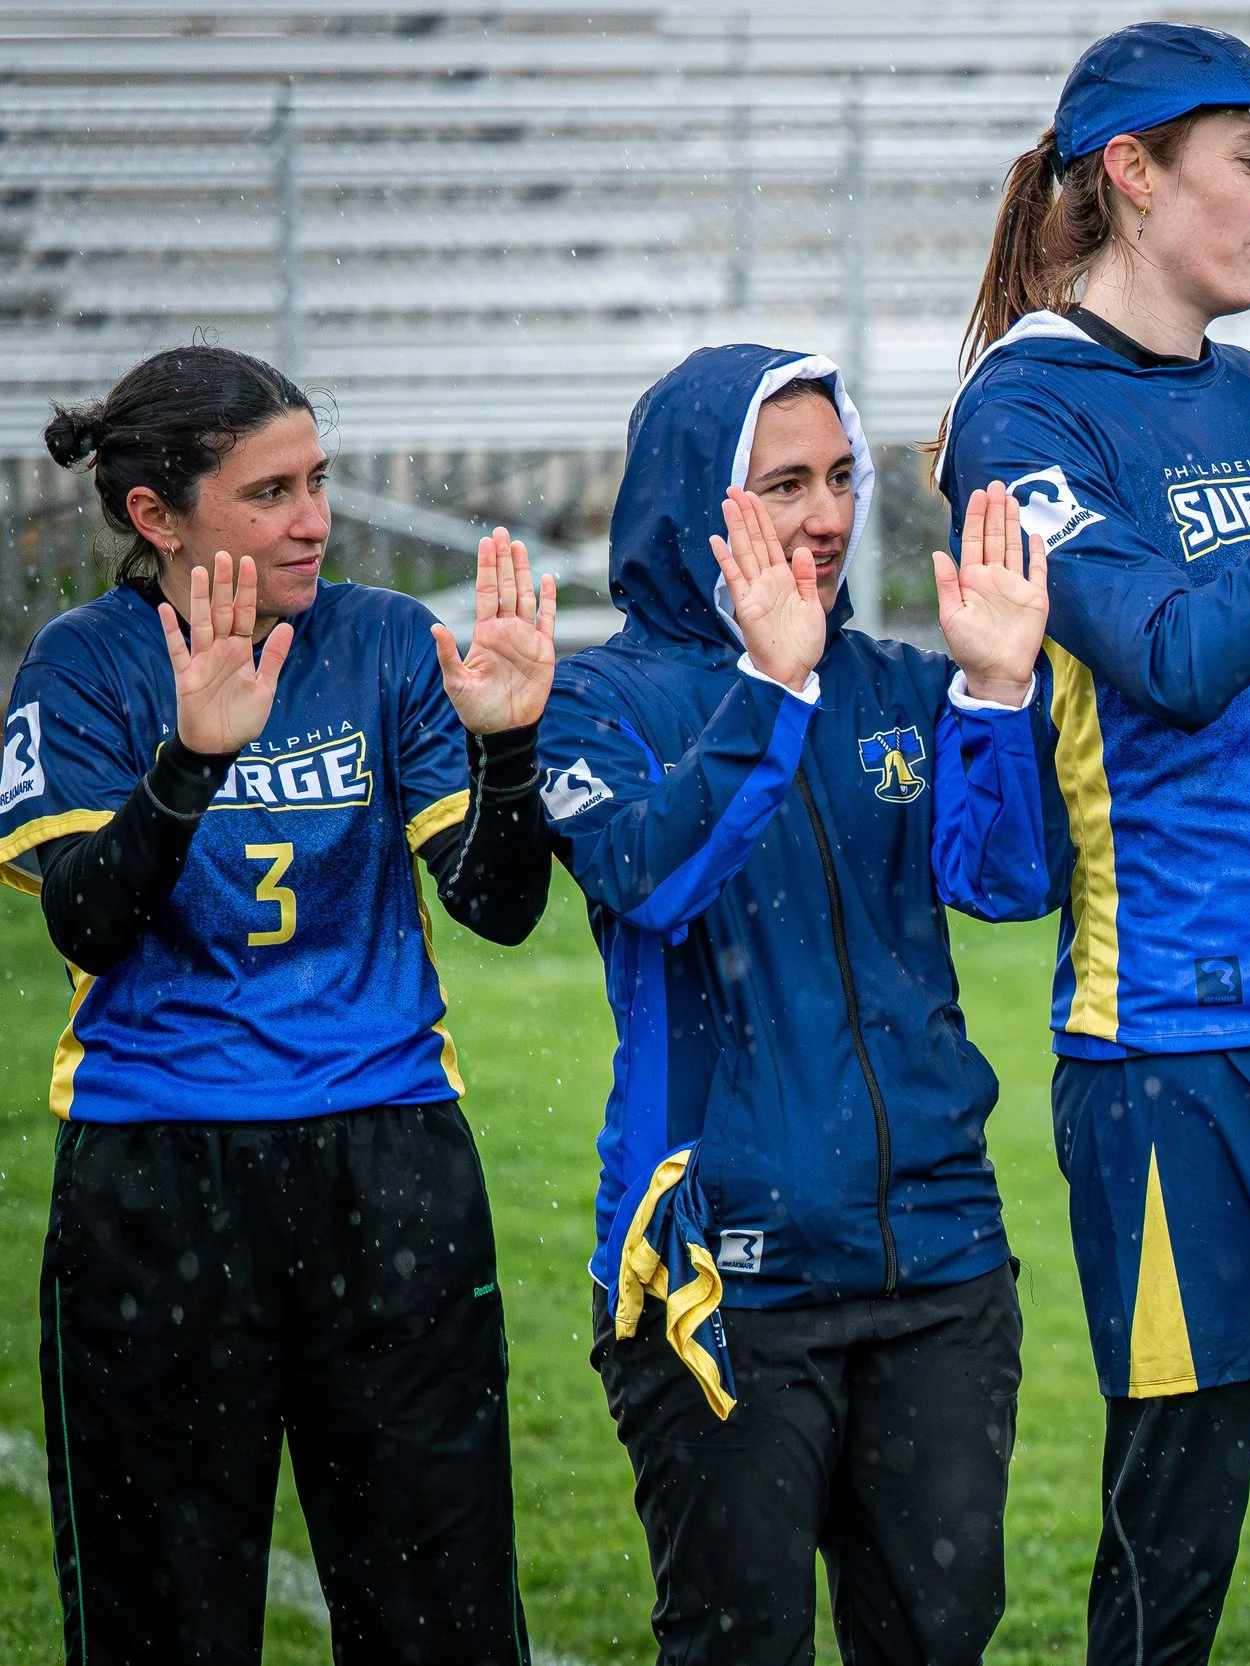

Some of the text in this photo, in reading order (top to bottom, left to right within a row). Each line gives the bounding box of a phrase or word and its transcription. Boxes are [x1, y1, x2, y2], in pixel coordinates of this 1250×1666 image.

[1046, 509, 1094, 547] BREAKMARK
[162, 720, 354, 753] PELPHIA
[212, 742, 367, 803] RGE
[0, 779, 34, 807] REAKMARK
[572, 792, 604, 816] AKMARK
[245, 842, 297, 947] 3
